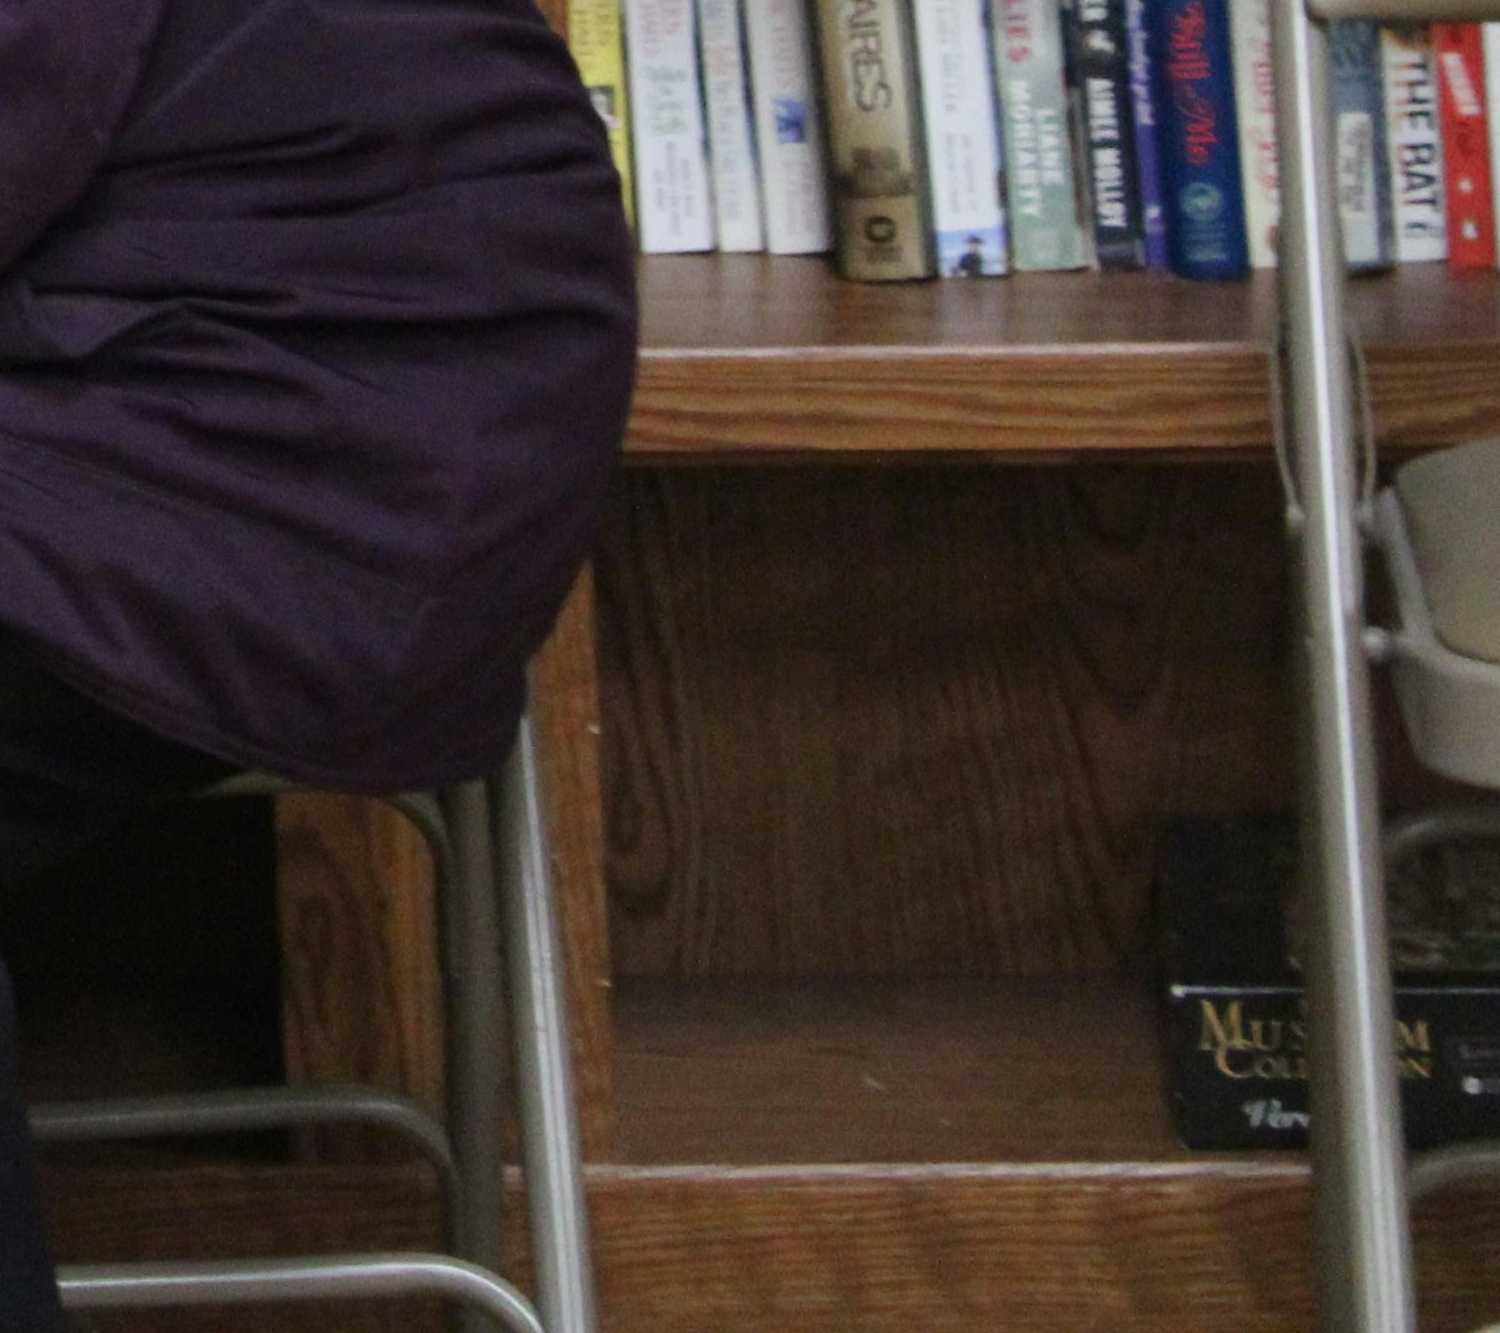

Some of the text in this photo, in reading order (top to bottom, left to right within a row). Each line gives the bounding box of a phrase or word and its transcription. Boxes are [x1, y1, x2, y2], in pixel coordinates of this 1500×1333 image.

[1009, 80, 1041, 220] MORIARTY
[1035, 106, 1064, 185] LIANE
[1088, 77, 1128, 228] AIMEE MOLLOY
[1166, 0, 1217, 166] Still Me
[1199, 998, 1432, 1051] MUSM
